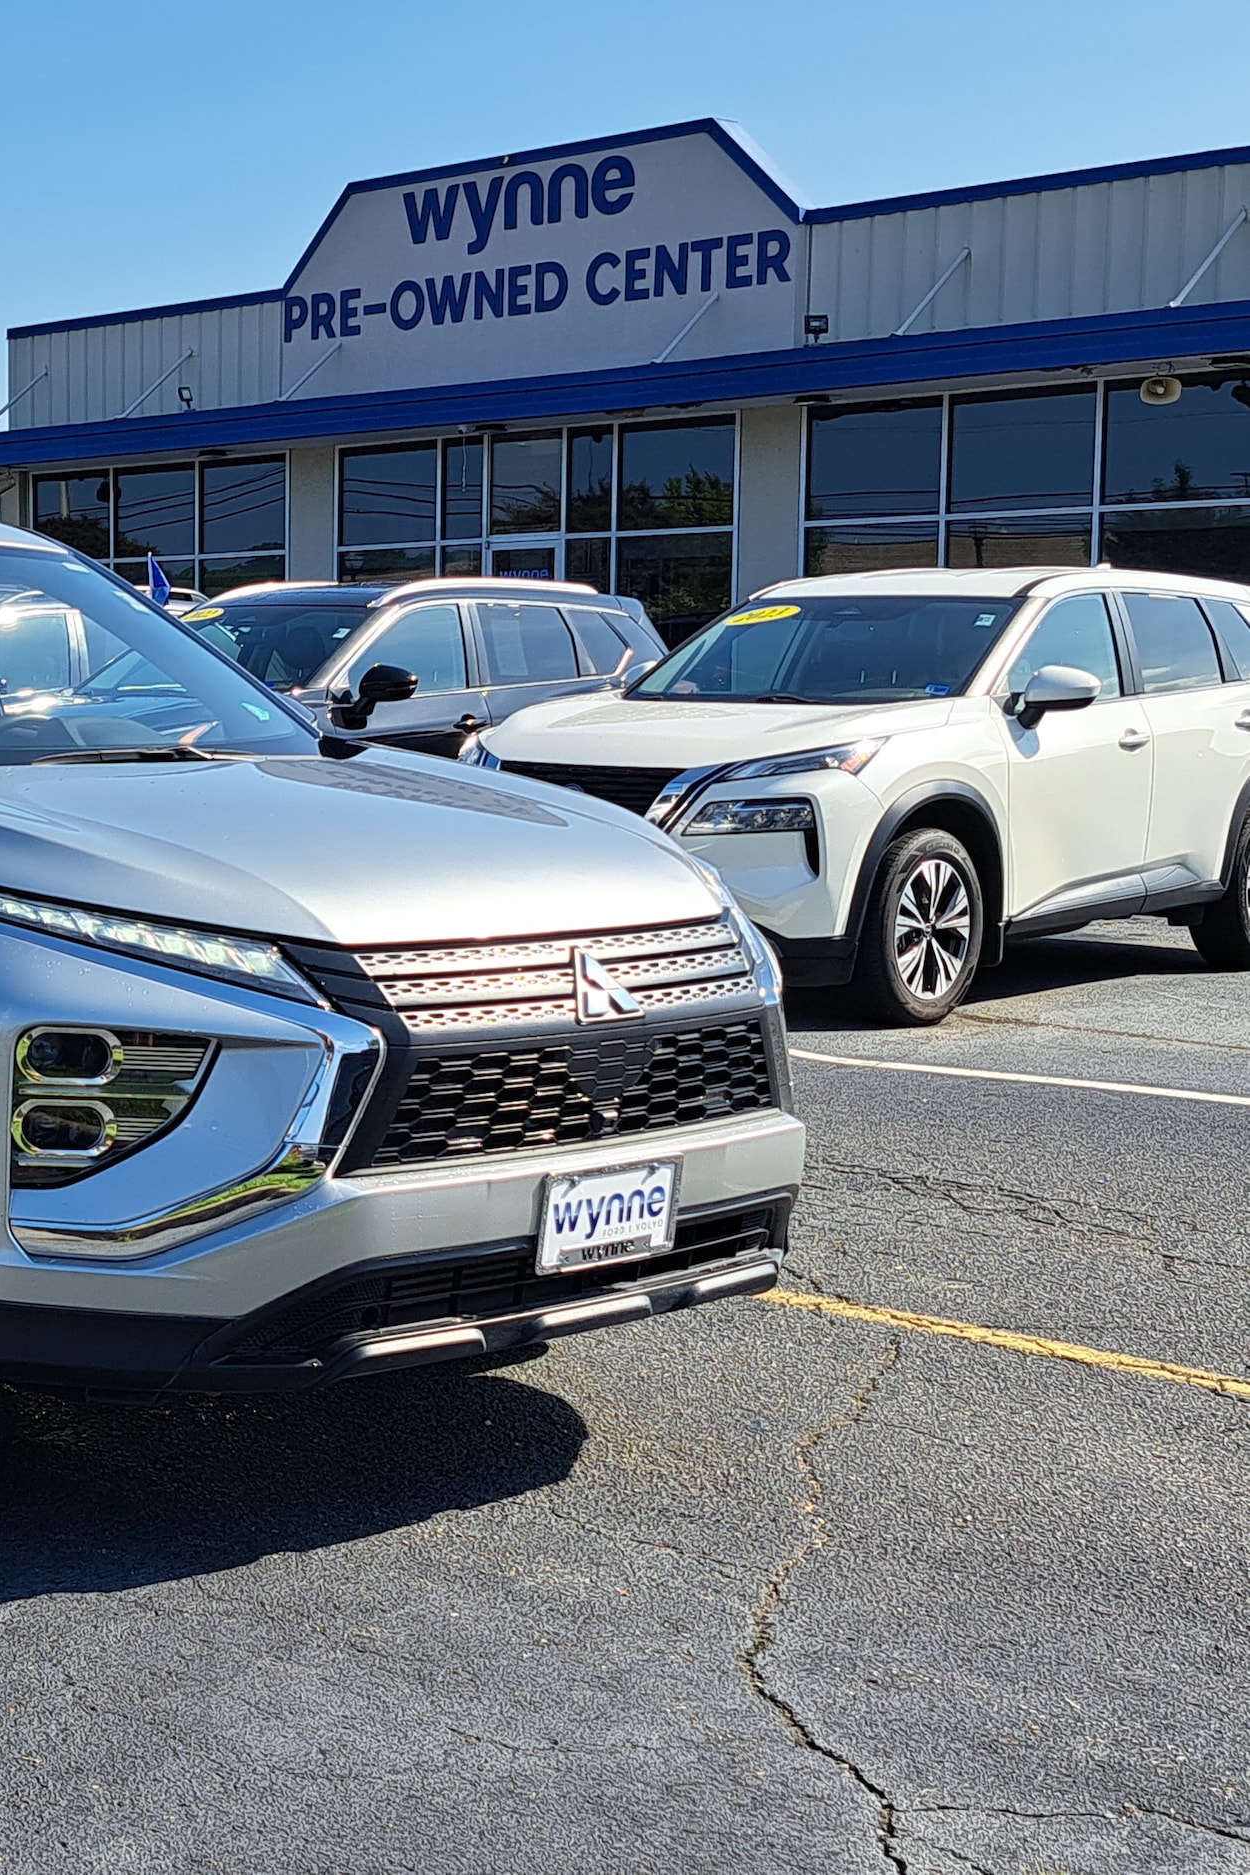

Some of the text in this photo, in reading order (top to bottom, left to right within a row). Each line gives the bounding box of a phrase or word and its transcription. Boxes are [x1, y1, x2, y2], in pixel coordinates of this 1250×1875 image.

[403, 155, 635, 254] wynne
[284, 229, 792, 342] PRE-OWNED CENTER
[553, 1186, 666, 1240] wynne
[602, 1219, 664, 1237] FORD VOLVO
